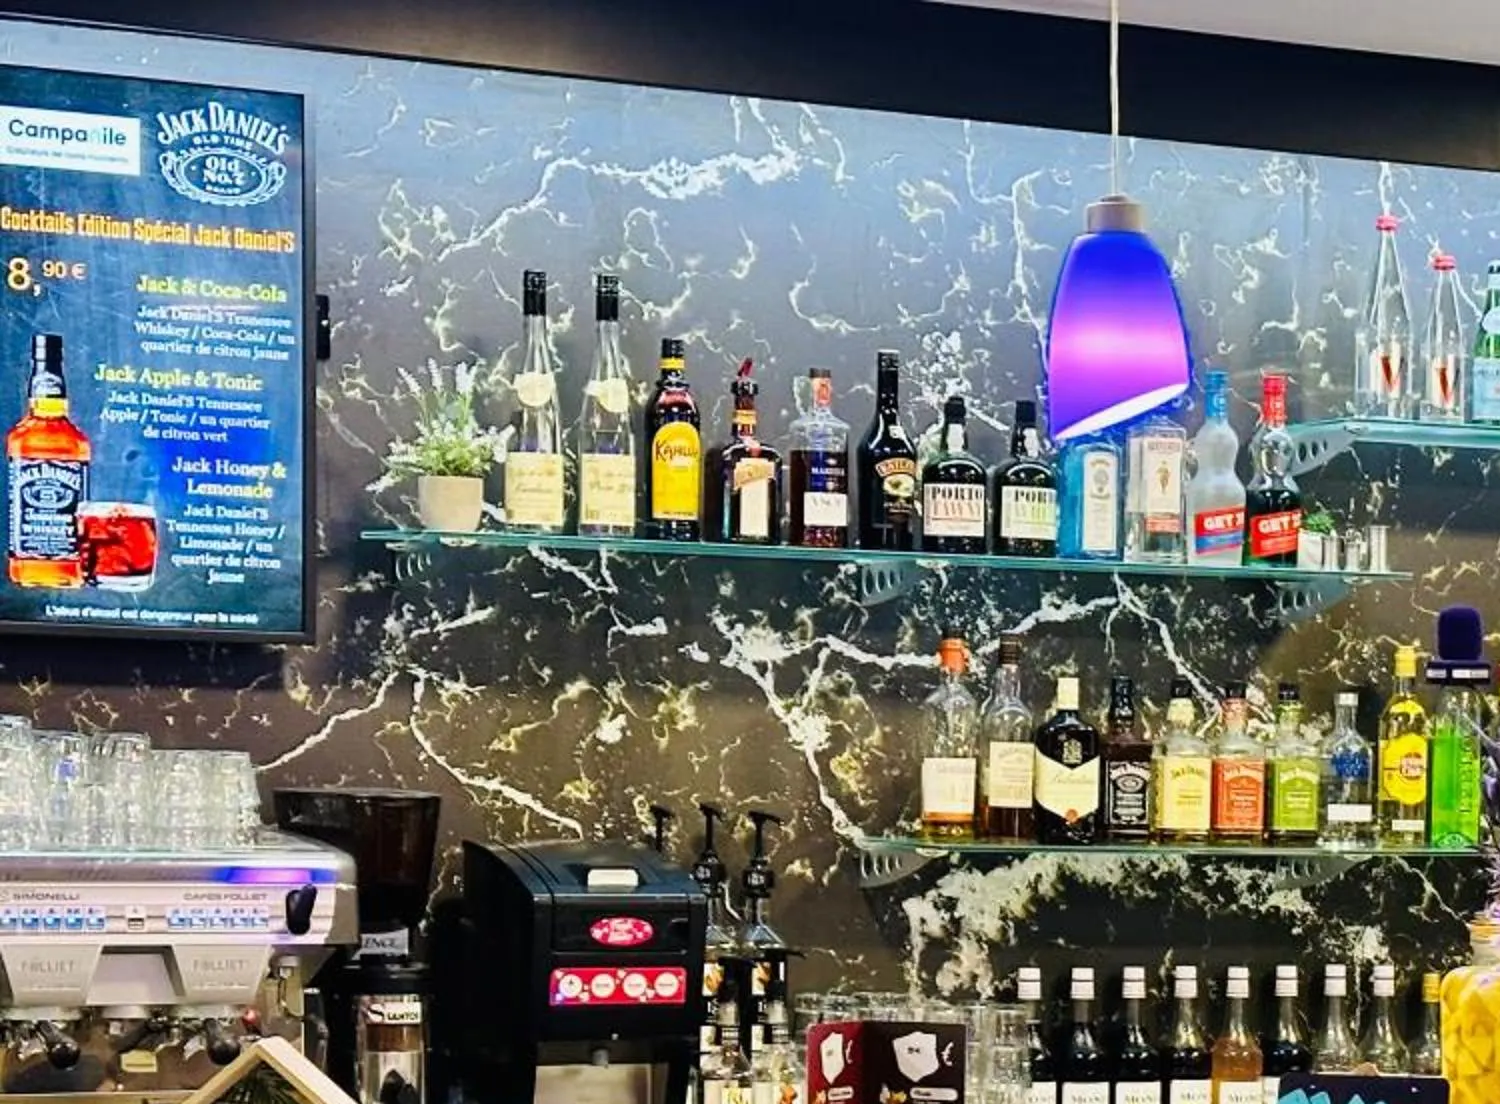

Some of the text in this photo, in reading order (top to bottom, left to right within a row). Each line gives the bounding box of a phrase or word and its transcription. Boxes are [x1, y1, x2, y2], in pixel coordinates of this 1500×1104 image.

[9, 119, 127, 144] Campanile
[157, 108, 208, 144] JACK
[1, 205, 75, 235] Cocktails
[78, 213, 131, 239] Edition
[193, 223, 231, 248] Jack
[136, 274, 178, 295] Jack
[200, 279, 288, 303] Coca-Cola
[94, 364, 264, 391] Jack Apple & Tonic
[108, 390, 139, 405] Jack
[100, 408, 140, 423] Apple
[150, 409, 187, 424] Tonic
[144, 426, 160, 439] de
[172, 456, 287, 480] Jack Honey &
[187, 478, 274, 498] Lemonade
[183, 503, 214, 517] Jack
